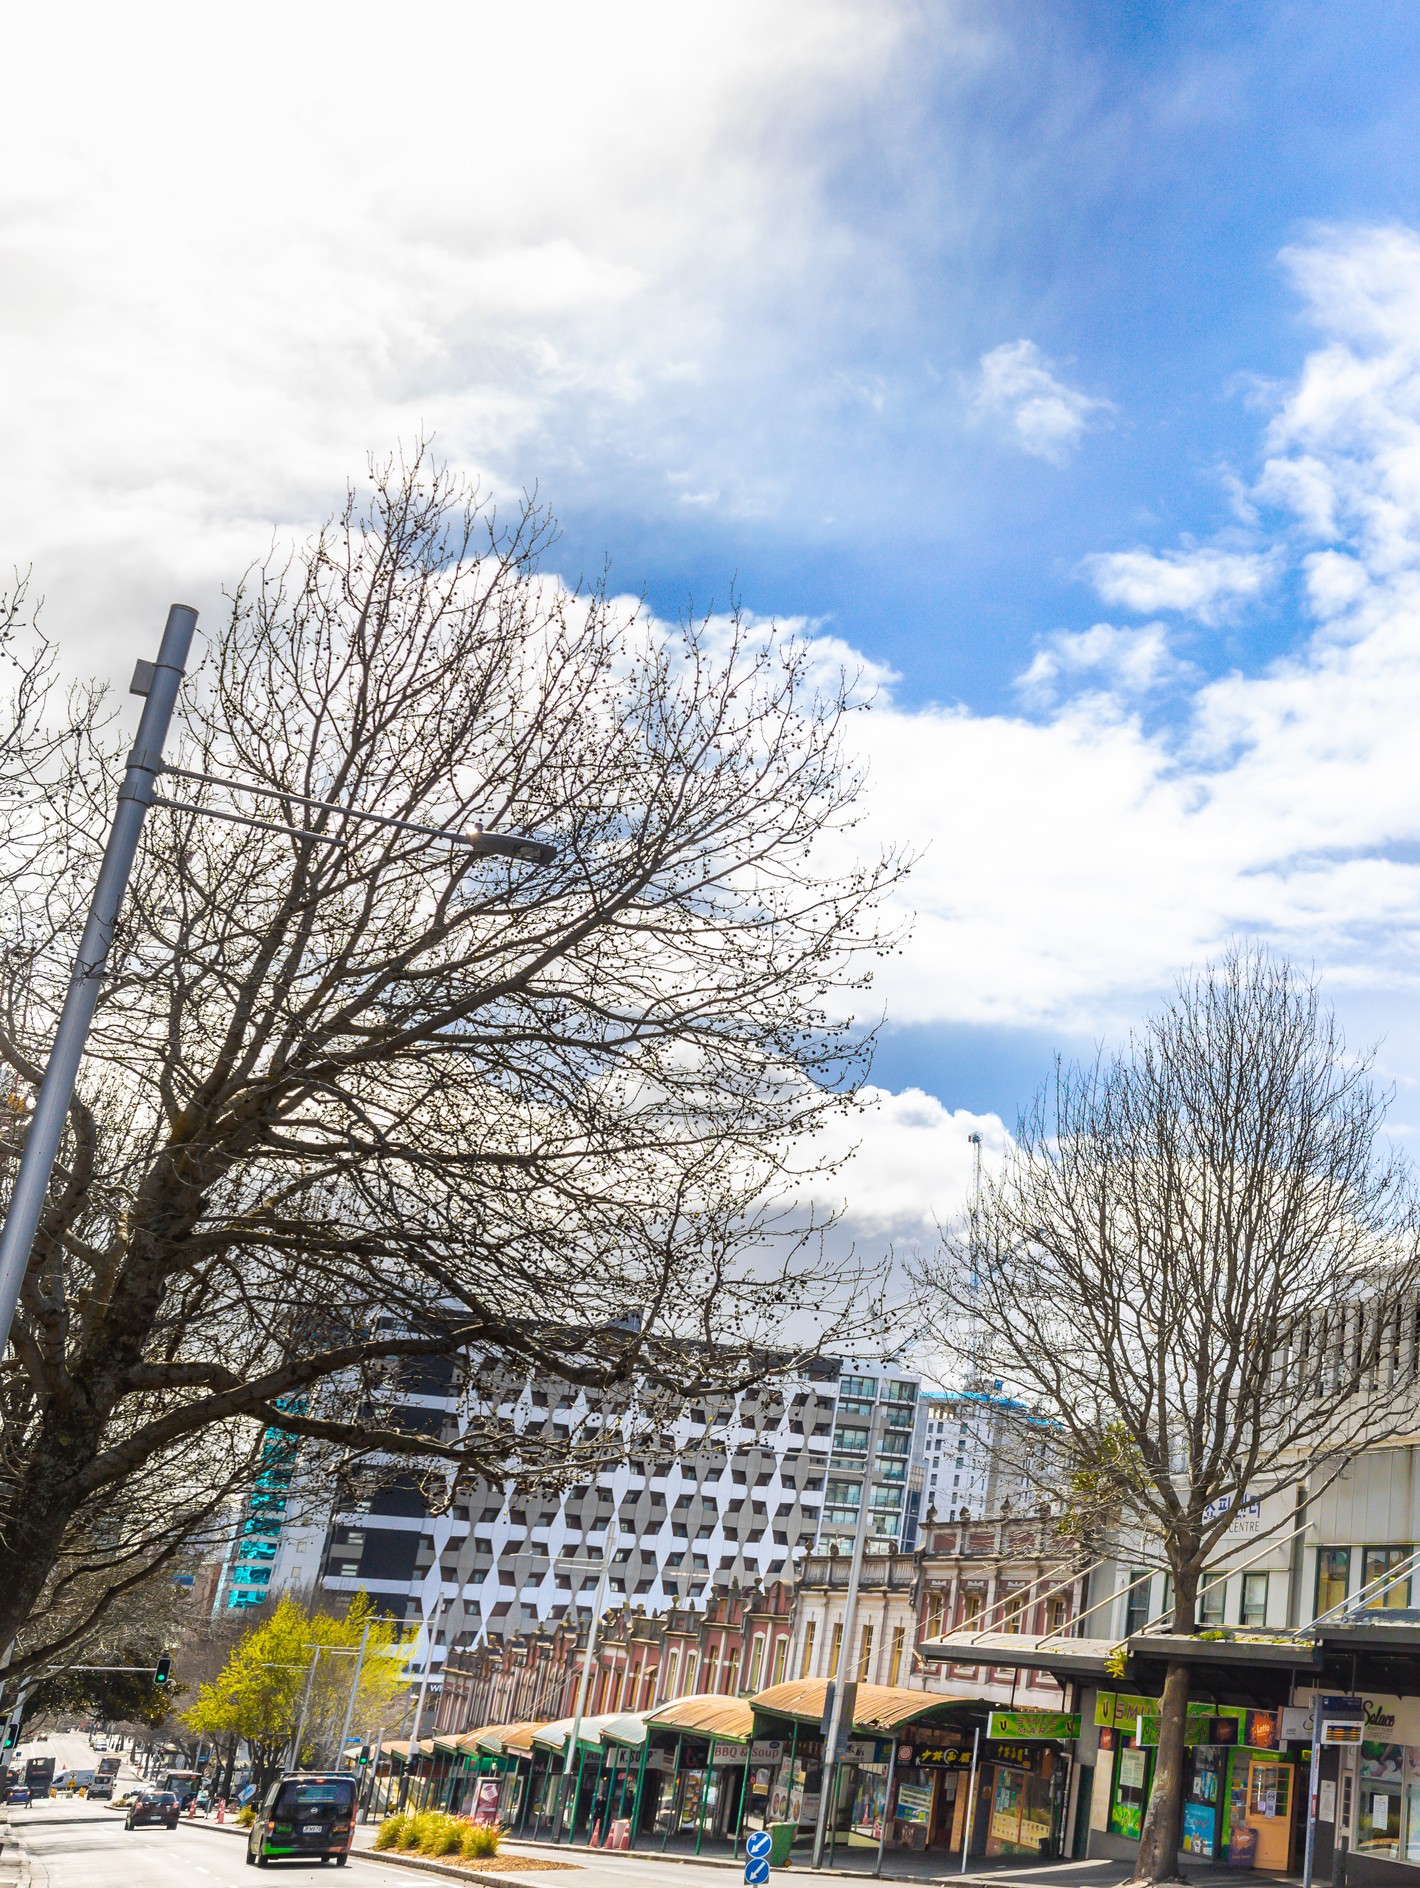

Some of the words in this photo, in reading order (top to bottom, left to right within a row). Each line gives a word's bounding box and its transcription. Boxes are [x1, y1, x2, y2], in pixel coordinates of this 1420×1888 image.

[1016, 1717, 1058, 1725] SMILE
[1016, 1727, 1057, 1735] MART
[1256, 1725, 1270, 1734] Lotto
[619, 1750, 653, 1763] K.SOP
[714, 1747, 737, 1760] BBQ
[751, 1747, 779, 1760] Soup
